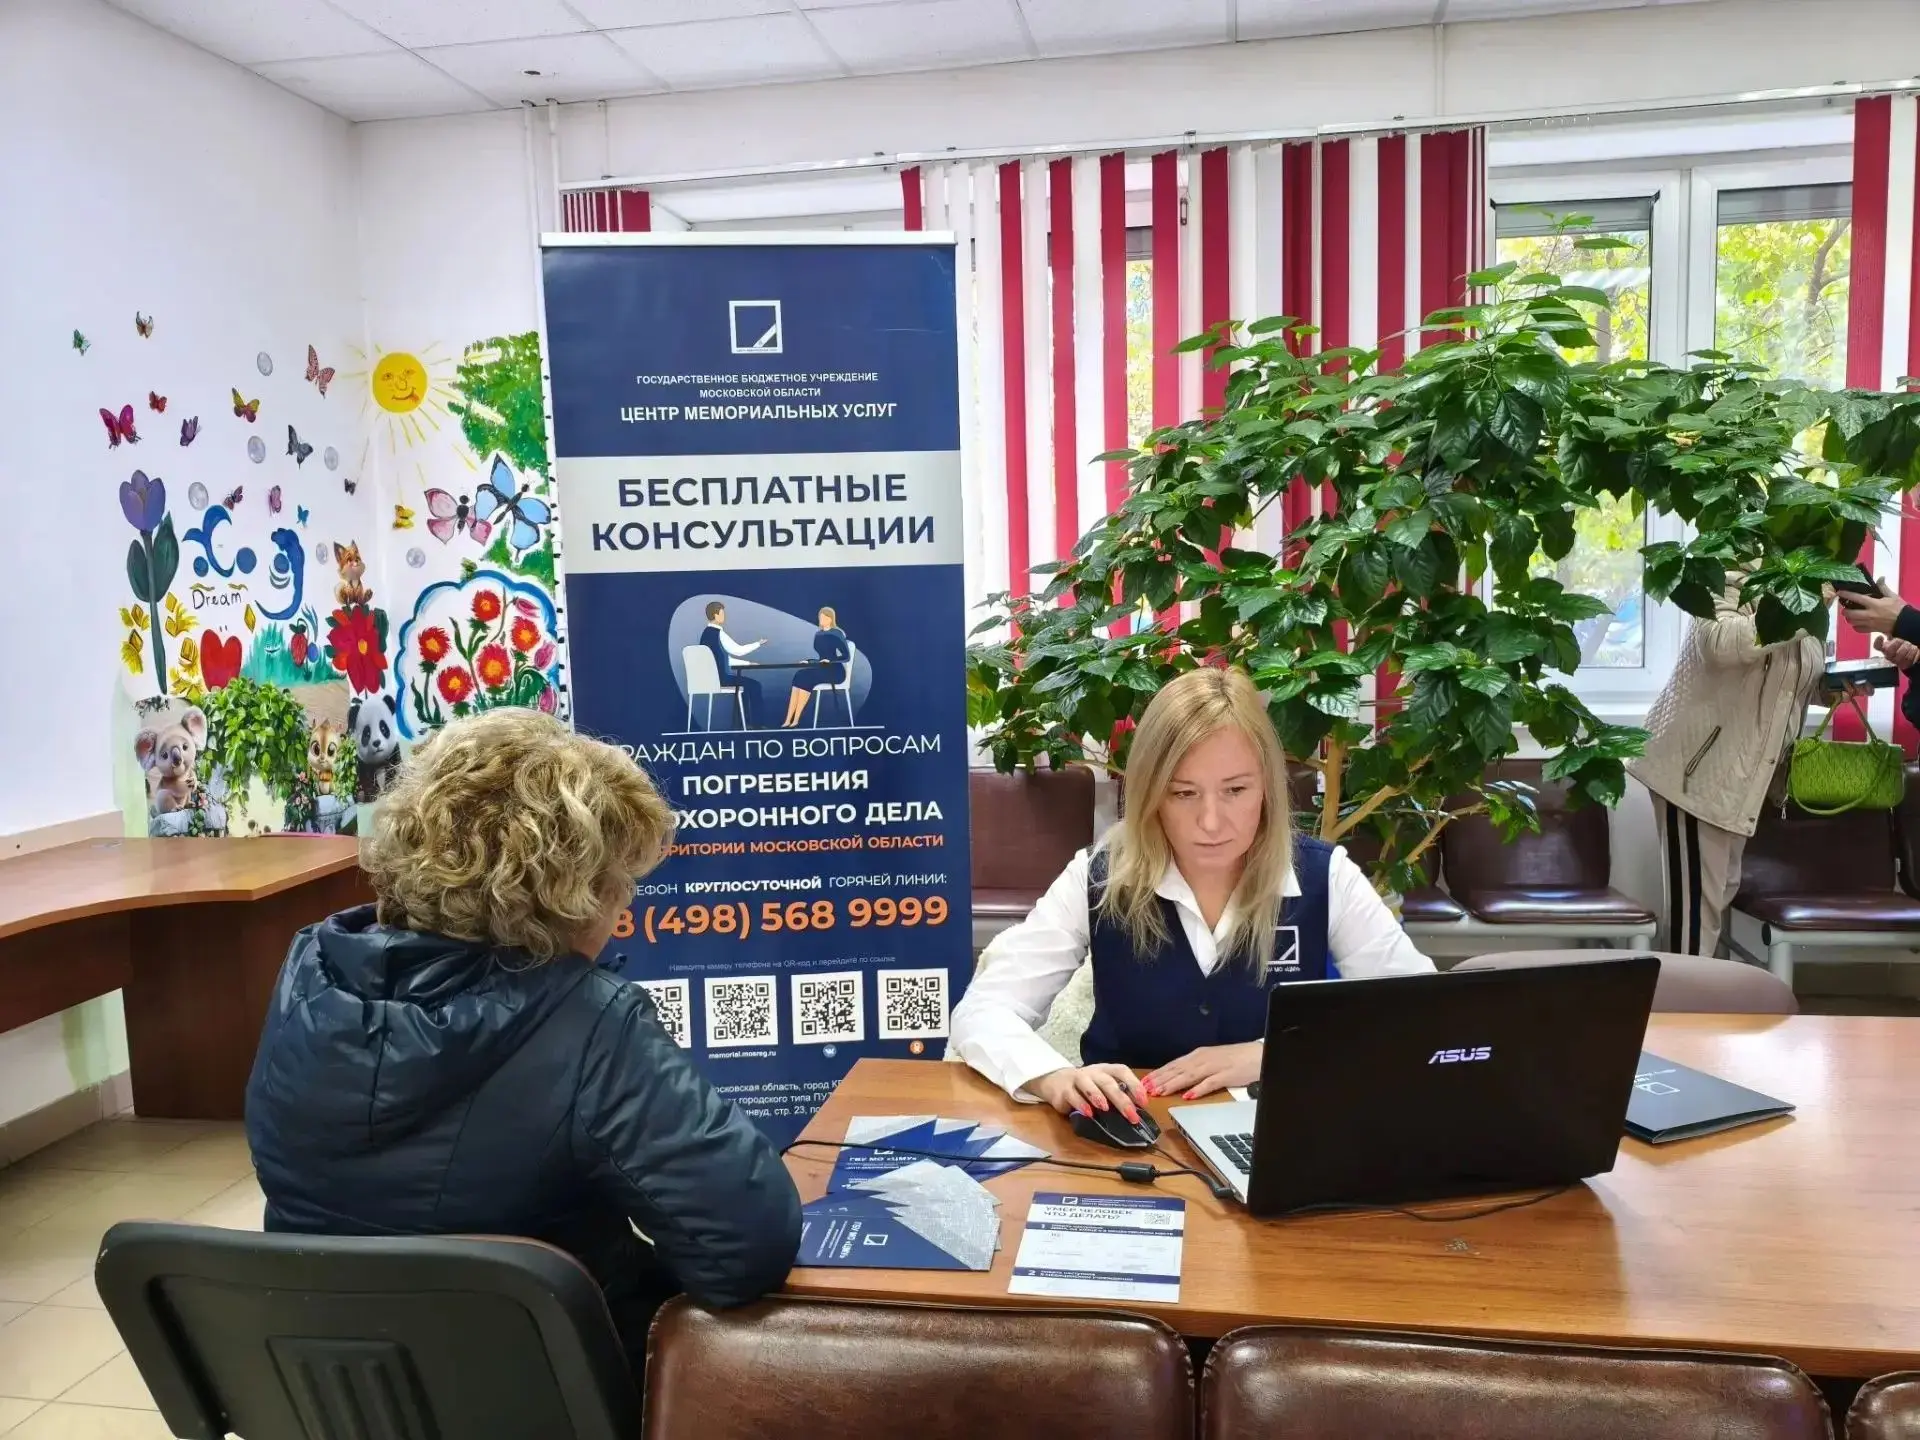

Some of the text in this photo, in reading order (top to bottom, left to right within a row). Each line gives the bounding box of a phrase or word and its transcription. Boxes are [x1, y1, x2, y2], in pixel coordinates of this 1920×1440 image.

[636, 372, 879, 386] ГОСУДАРСТВЕННОЕ БЮДЖЕТНОЕ УЧРЕЖДЕНИЕ
[699, 386, 821, 399] МОСКОВСКОЙ ОБЛАСТИ
[620, 402, 898, 424] ЦЕНТР МЕМОРИАЛЬНЫХ УСЛУГ
[619, 474, 907, 507] БЕСПЛАТНЫЕ
[592, 516, 934, 551] КОНСУЛЬТАЦИИ
[192, 589, 242, 609] Dream
[620, 735, 941, 765] РАЖДАН ПО ВОПРОСАМ
[683, 770, 868, 795] ПОГРЕБЕНИЯ
[672, 801, 943, 829] ХОРОННОГО ДЕЛА
[665, 835, 943, 856] РИТОРИИ МОСКОВСКОЙ ОБЛАСТИ
[636, 873, 946, 896] ЕФОН КРУГЛОСУТОЧНОЙ ГОРЯЧЕЙ ЛИНИИ:
[645, 903, 750, 943] (498)
[761, 901, 835, 931] 568
[848, 896, 947, 927] 9999
[708, 1050, 777, 1059] memorial.mosreg.ru
[1429, 1047, 1491, 1064] ASUS
[715, 1085, 760, 1093] осковская
[803, 1081, 830, 1091] город
[738, 1095, 788, 1106] городского
[790, 1094, 811, 1102] типа
[1069, 1212, 1121, 1220] ДЕЛАТЬ?
[1080, 1207, 1133, 1215] ЧЕЛОВЕК
